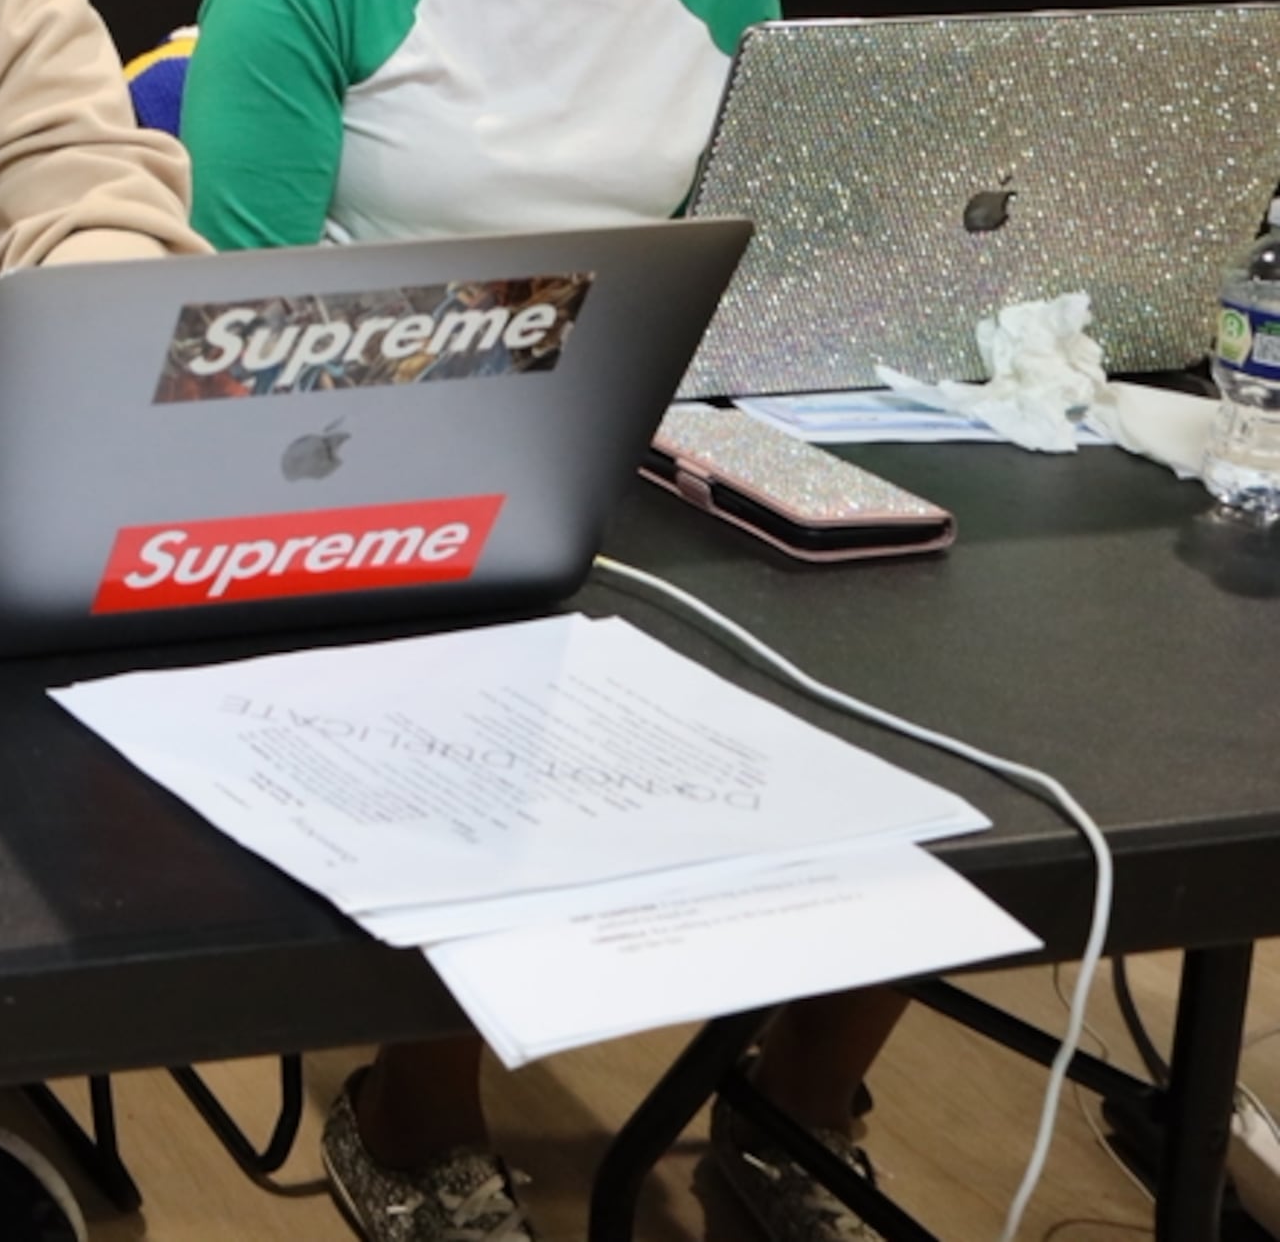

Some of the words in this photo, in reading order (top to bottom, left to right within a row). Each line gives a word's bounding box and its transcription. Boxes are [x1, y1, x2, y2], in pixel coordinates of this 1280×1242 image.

[188, 303, 557, 388] Supreme
[123, 521, 470, 598] Supreme
[540, 759, 656, 798] NOT
